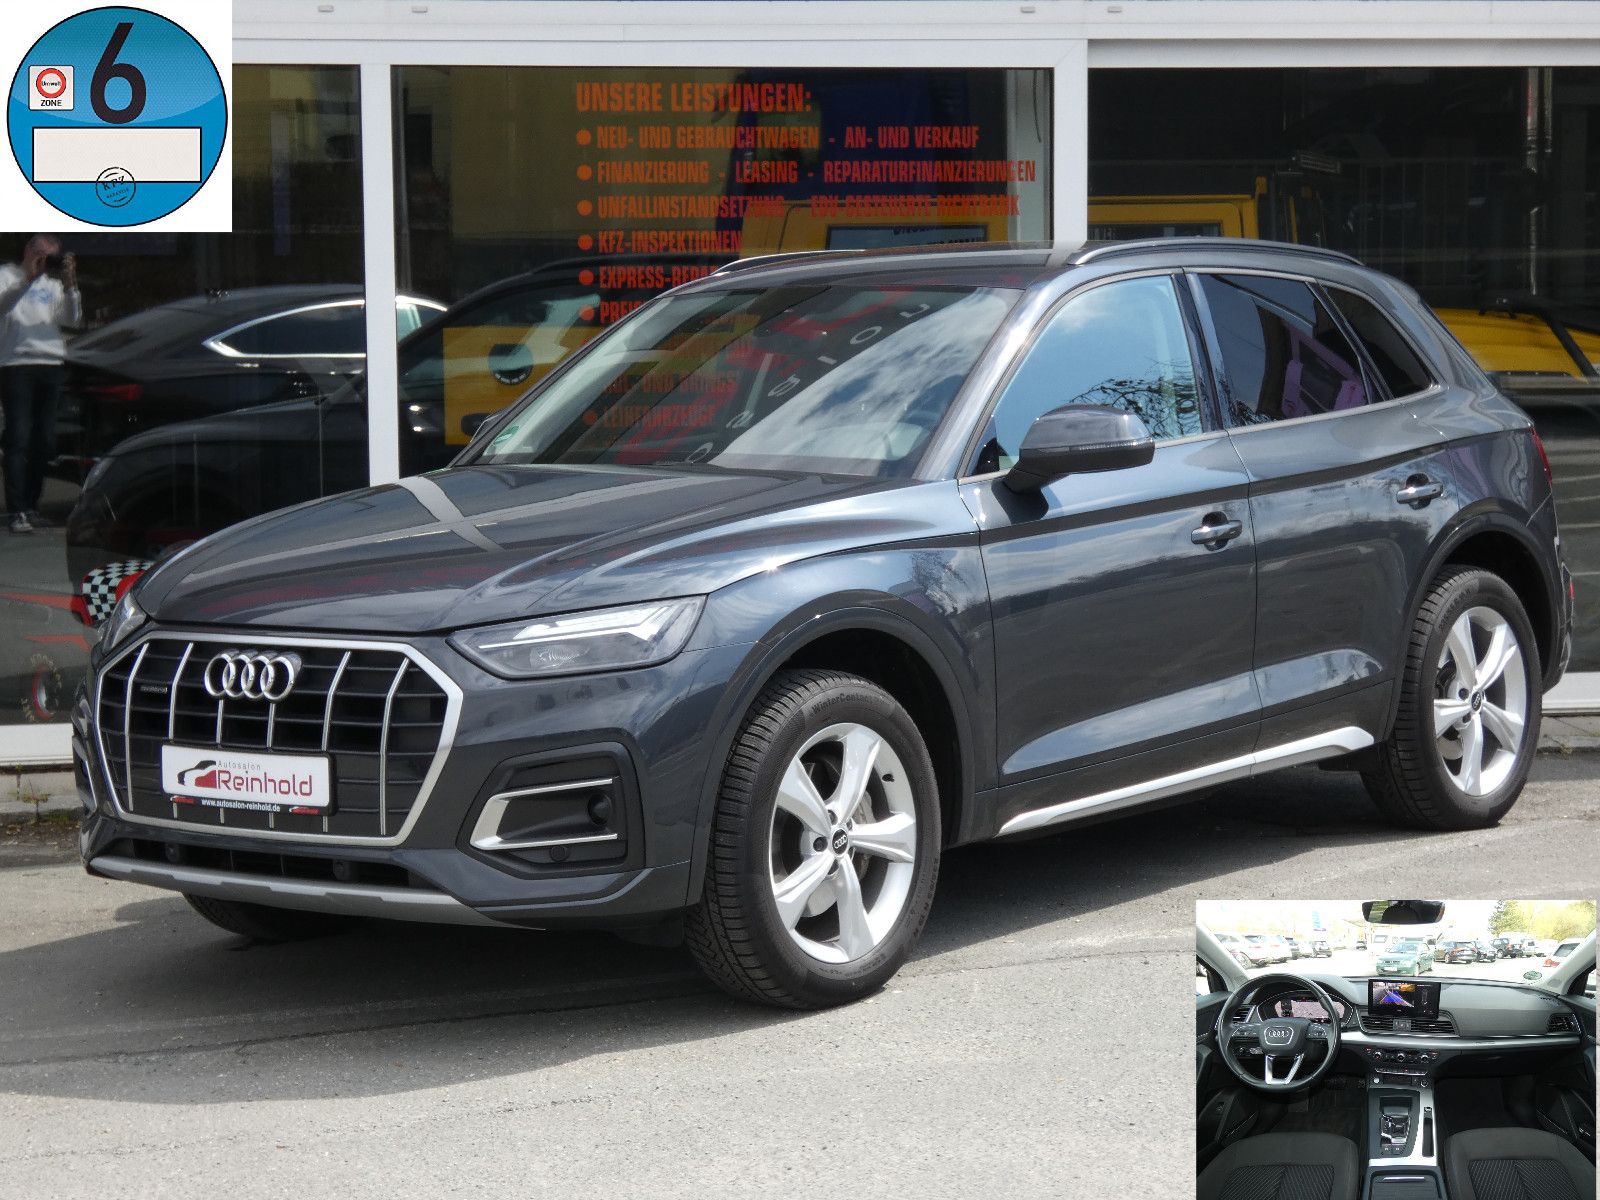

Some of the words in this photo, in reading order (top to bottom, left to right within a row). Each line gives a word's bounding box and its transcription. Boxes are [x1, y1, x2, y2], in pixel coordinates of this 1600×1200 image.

[576, 82, 662, 112] UNSERE
[671, 82, 812, 112] LEISTUNGEN:
[597, 126, 634, 148] NEU-
[639, 126, 671, 148] UND
[677, 126, 820, 149] GEBRAUCHTWAGEN
[844, 126, 873, 148] AN-
[878, 126, 910, 148] UND
[914, 126, 980, 148] VERKAUF
[597, 160, 709, 183] FINANZIERUNG
[735, 160, 798, 183] LEASING
[823, 160, 1036, 182] REPARATURFINANZIERUNGEN
[598, 195, 785, 218] UNFALLINSTANDSETZUNG
[599, 230, 742, 253] KFZ-INSPEKTIONEN
[600, 265, 719, 288] EXPRESS-REP
[217, 759, 261, 771] Autosalon
[217, 769, 313, 797] Reinhold
[201, 798, 281, 812] www.autosalon-reinhold.de
